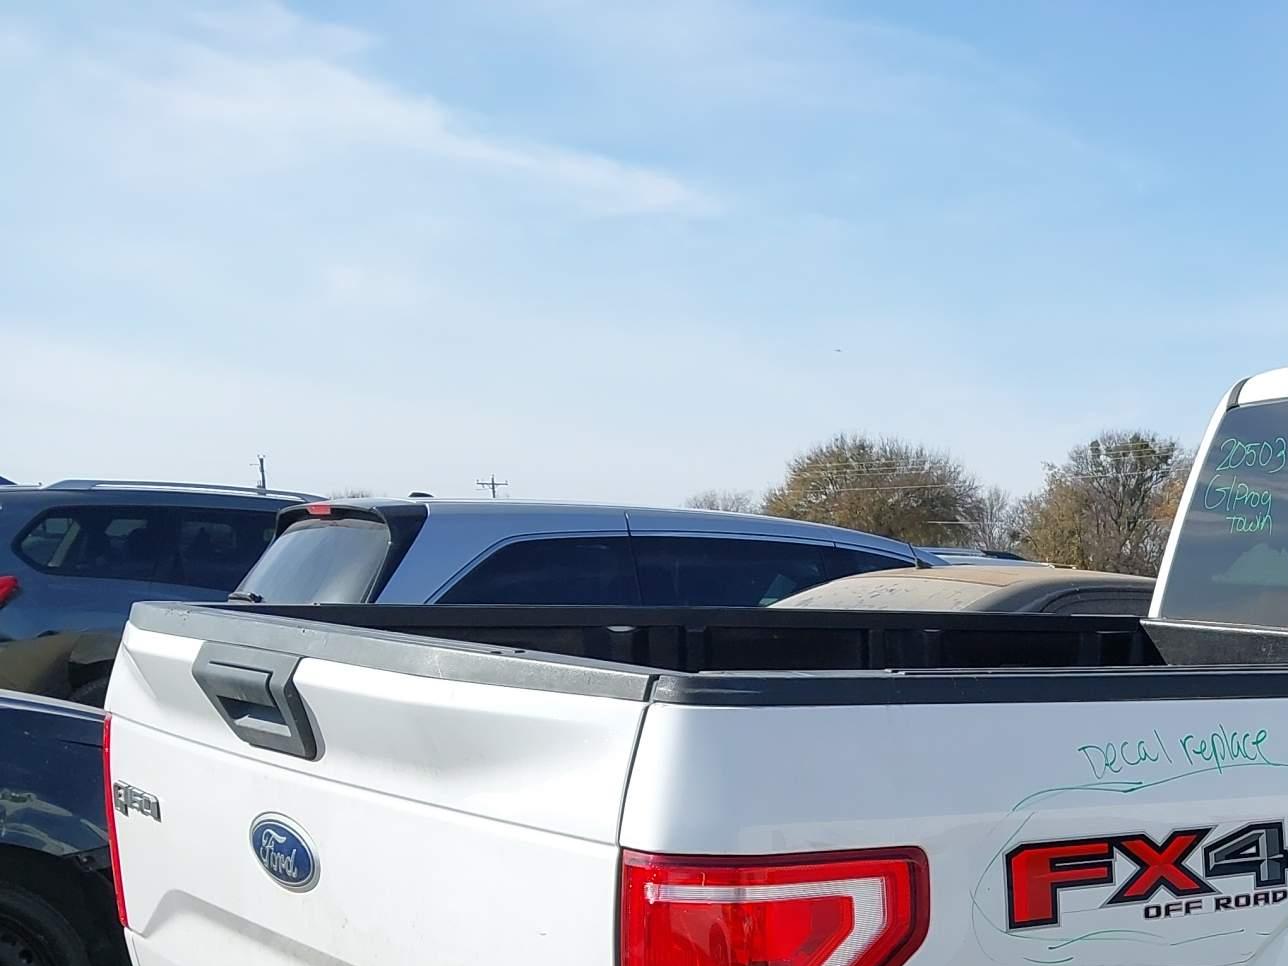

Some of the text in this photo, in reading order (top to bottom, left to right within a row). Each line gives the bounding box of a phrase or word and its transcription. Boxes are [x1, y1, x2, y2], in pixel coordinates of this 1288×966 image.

[1216, 437, 1287, 474] 20503
[1078, 723, 1270, 779] Decal replace
[260, 828, 298, 879] Ford
[1143, 889, 1288, 921] OFF ROAD
